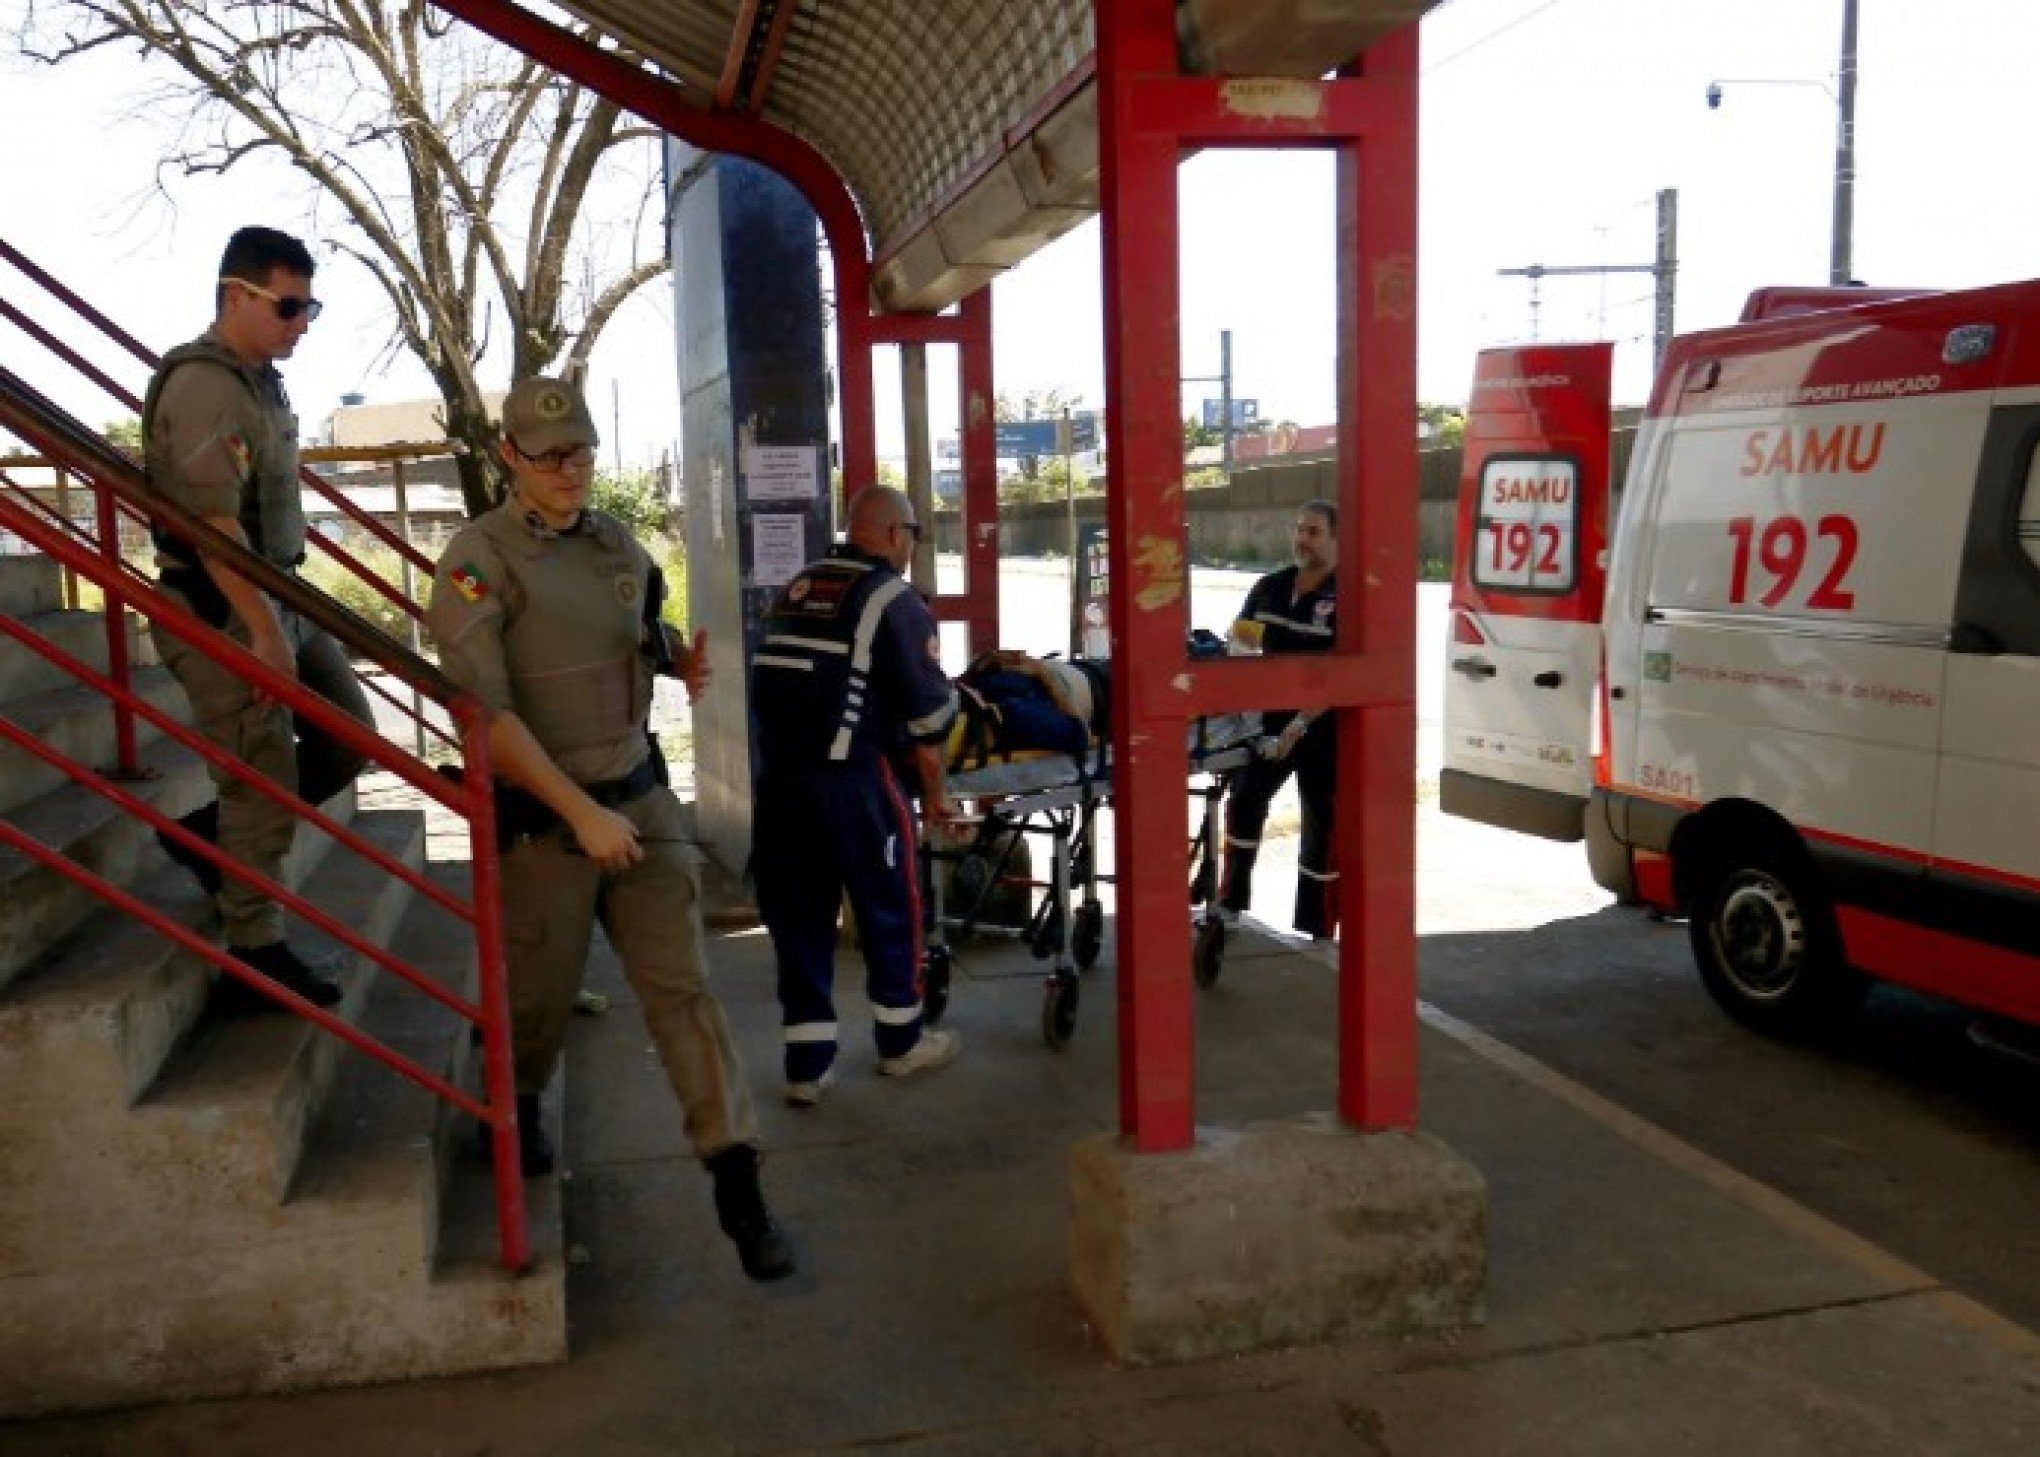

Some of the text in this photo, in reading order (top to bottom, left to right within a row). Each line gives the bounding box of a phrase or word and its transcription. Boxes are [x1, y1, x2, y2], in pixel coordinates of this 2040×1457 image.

[1853, 373, 1941, 397] AVANÇADO
[1740, 422, 1887, 478] SAMU
[1493, 476, 1569, 504] SAMU
[1490, 522, 1561, 574] 192
[1728, 515, 1858, 609] 192
